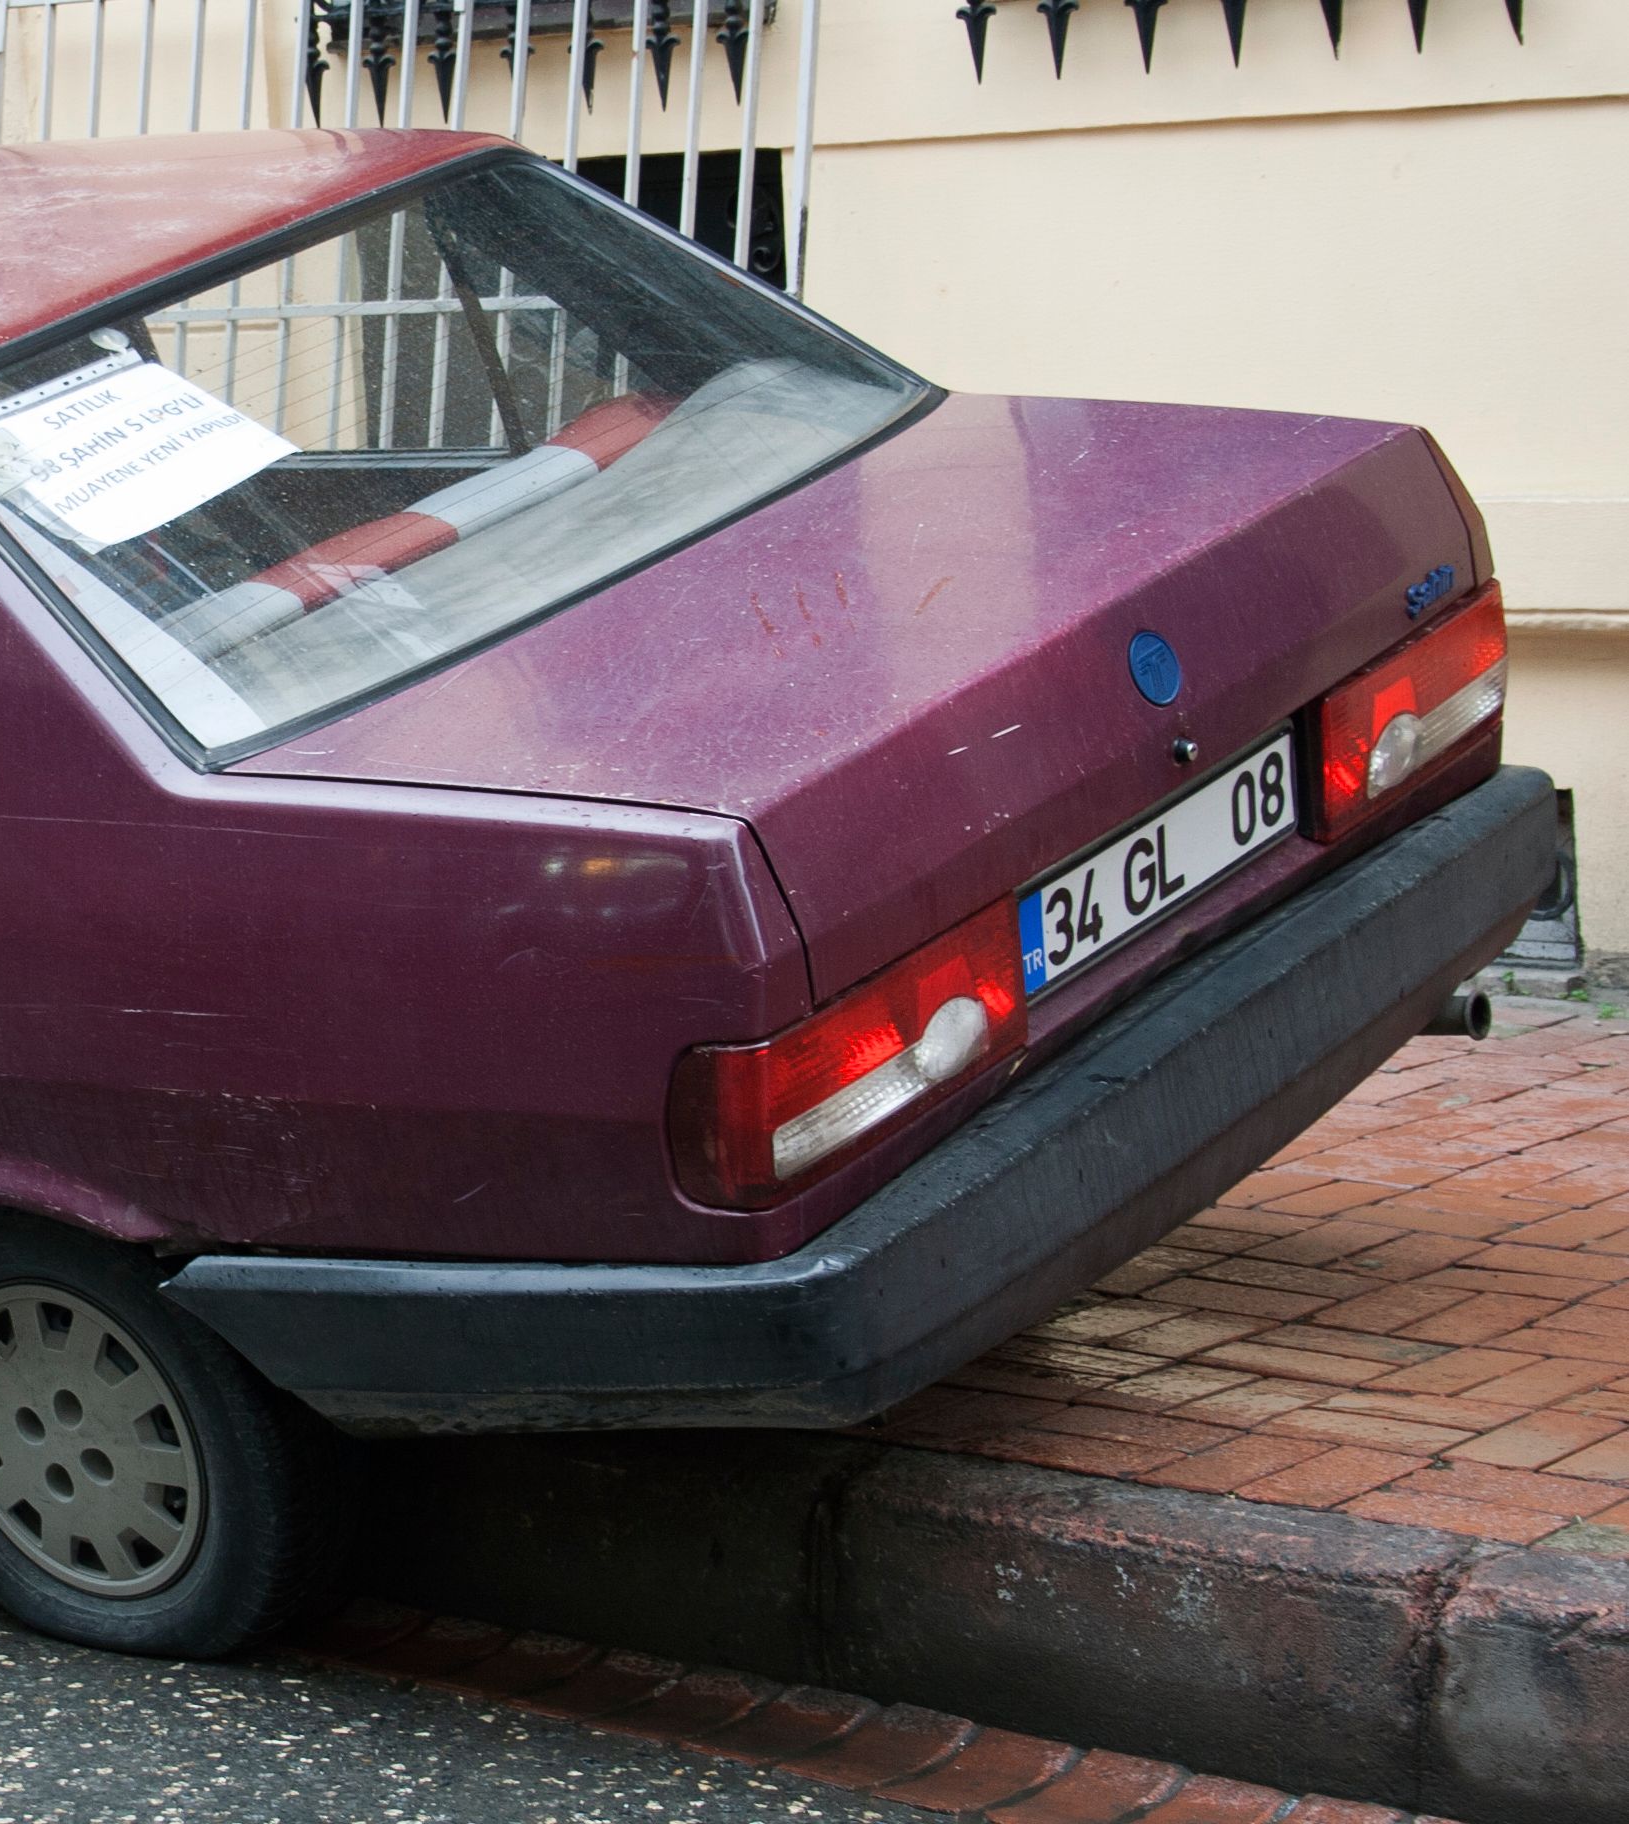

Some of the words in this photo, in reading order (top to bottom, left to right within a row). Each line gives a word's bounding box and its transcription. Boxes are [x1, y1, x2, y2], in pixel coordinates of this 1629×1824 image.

[30, 459, 63, 483] 98
[59, 426, 128, 469] ŞAHİN
[124, 417, 144, 432] S
[43, 389, 122, 430] SATILIK
[53, 461, 145, 516] MUAYENE
[139, 434, 185, 467] YENİ
[179, 413, 246, 443] YAPILDI
[1022, 947, 1044, 975] TR
[1044, 867, 1104, 967] 34
[1123, 823, 1185, 917] GL
[1231, 751, 1285, 847] 08
